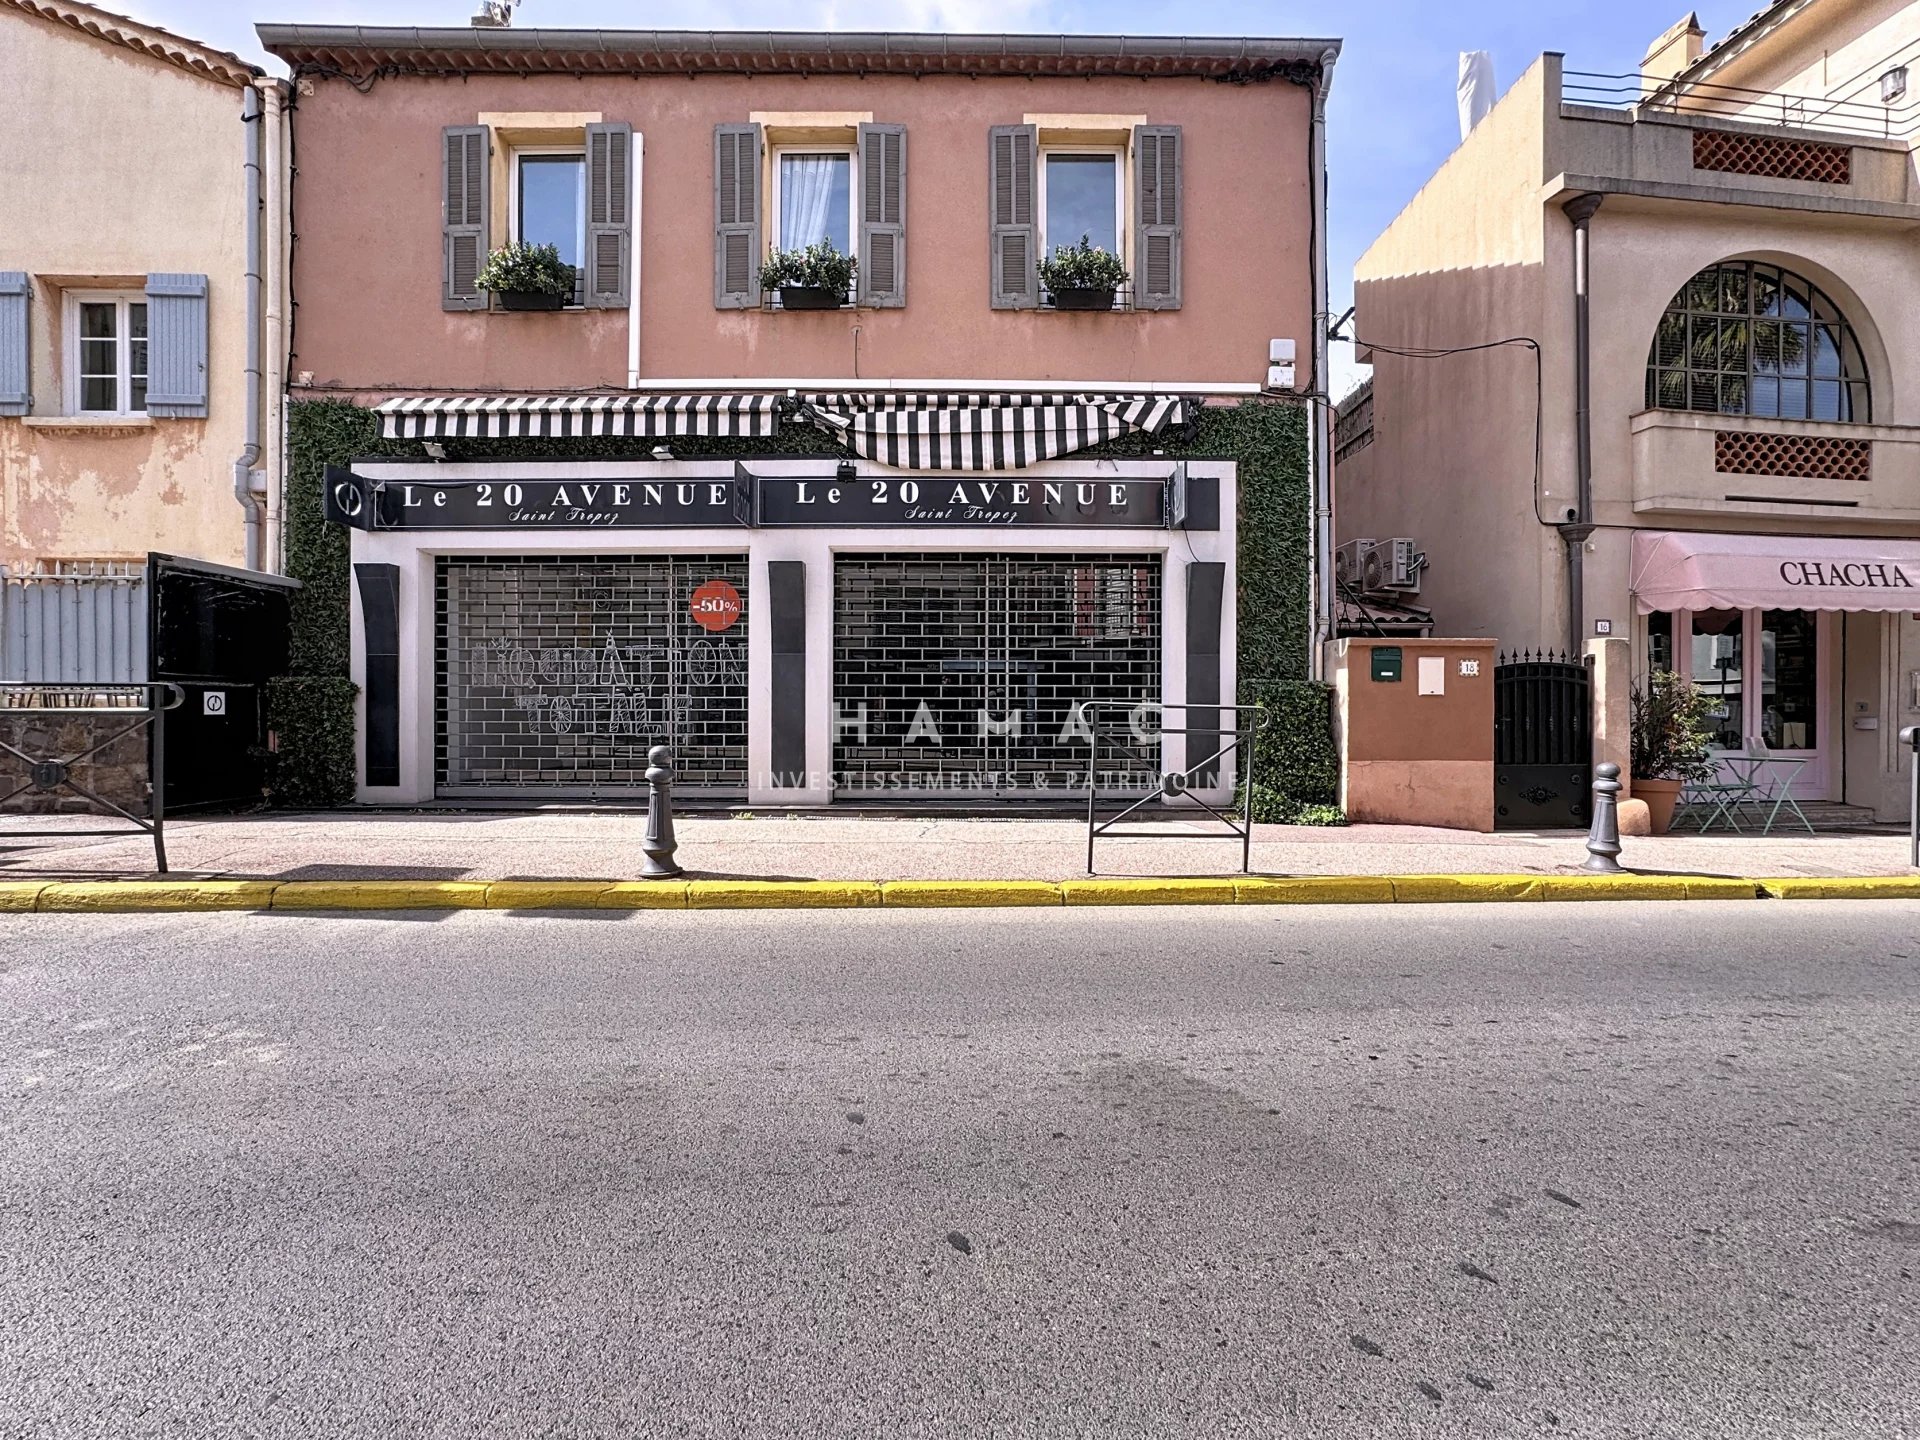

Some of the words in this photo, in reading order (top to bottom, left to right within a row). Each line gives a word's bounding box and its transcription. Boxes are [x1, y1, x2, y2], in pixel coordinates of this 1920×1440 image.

[402, 484, 447, 507] Le
[476, 483, 523, 507] 20
[552, 483, 728, 507] AVENUE
[795, 481, 841, 506] Le
[871, 480, 920, 506] 20
[948, 481, 1129, 506] AVENUE
[508, 507, 556, 522] Saint
[565, 506, 620, 525] Tropez
[904, 505, 953, 521] Saint
[963, 505, 1019, 524] Tropez
[1779, 561, 1914, 589] CHACHA
[692, 596, 739, 612] -50%
[1600, 623, 1607, 631] 16
[1466, 663, 1475, 672] 18
